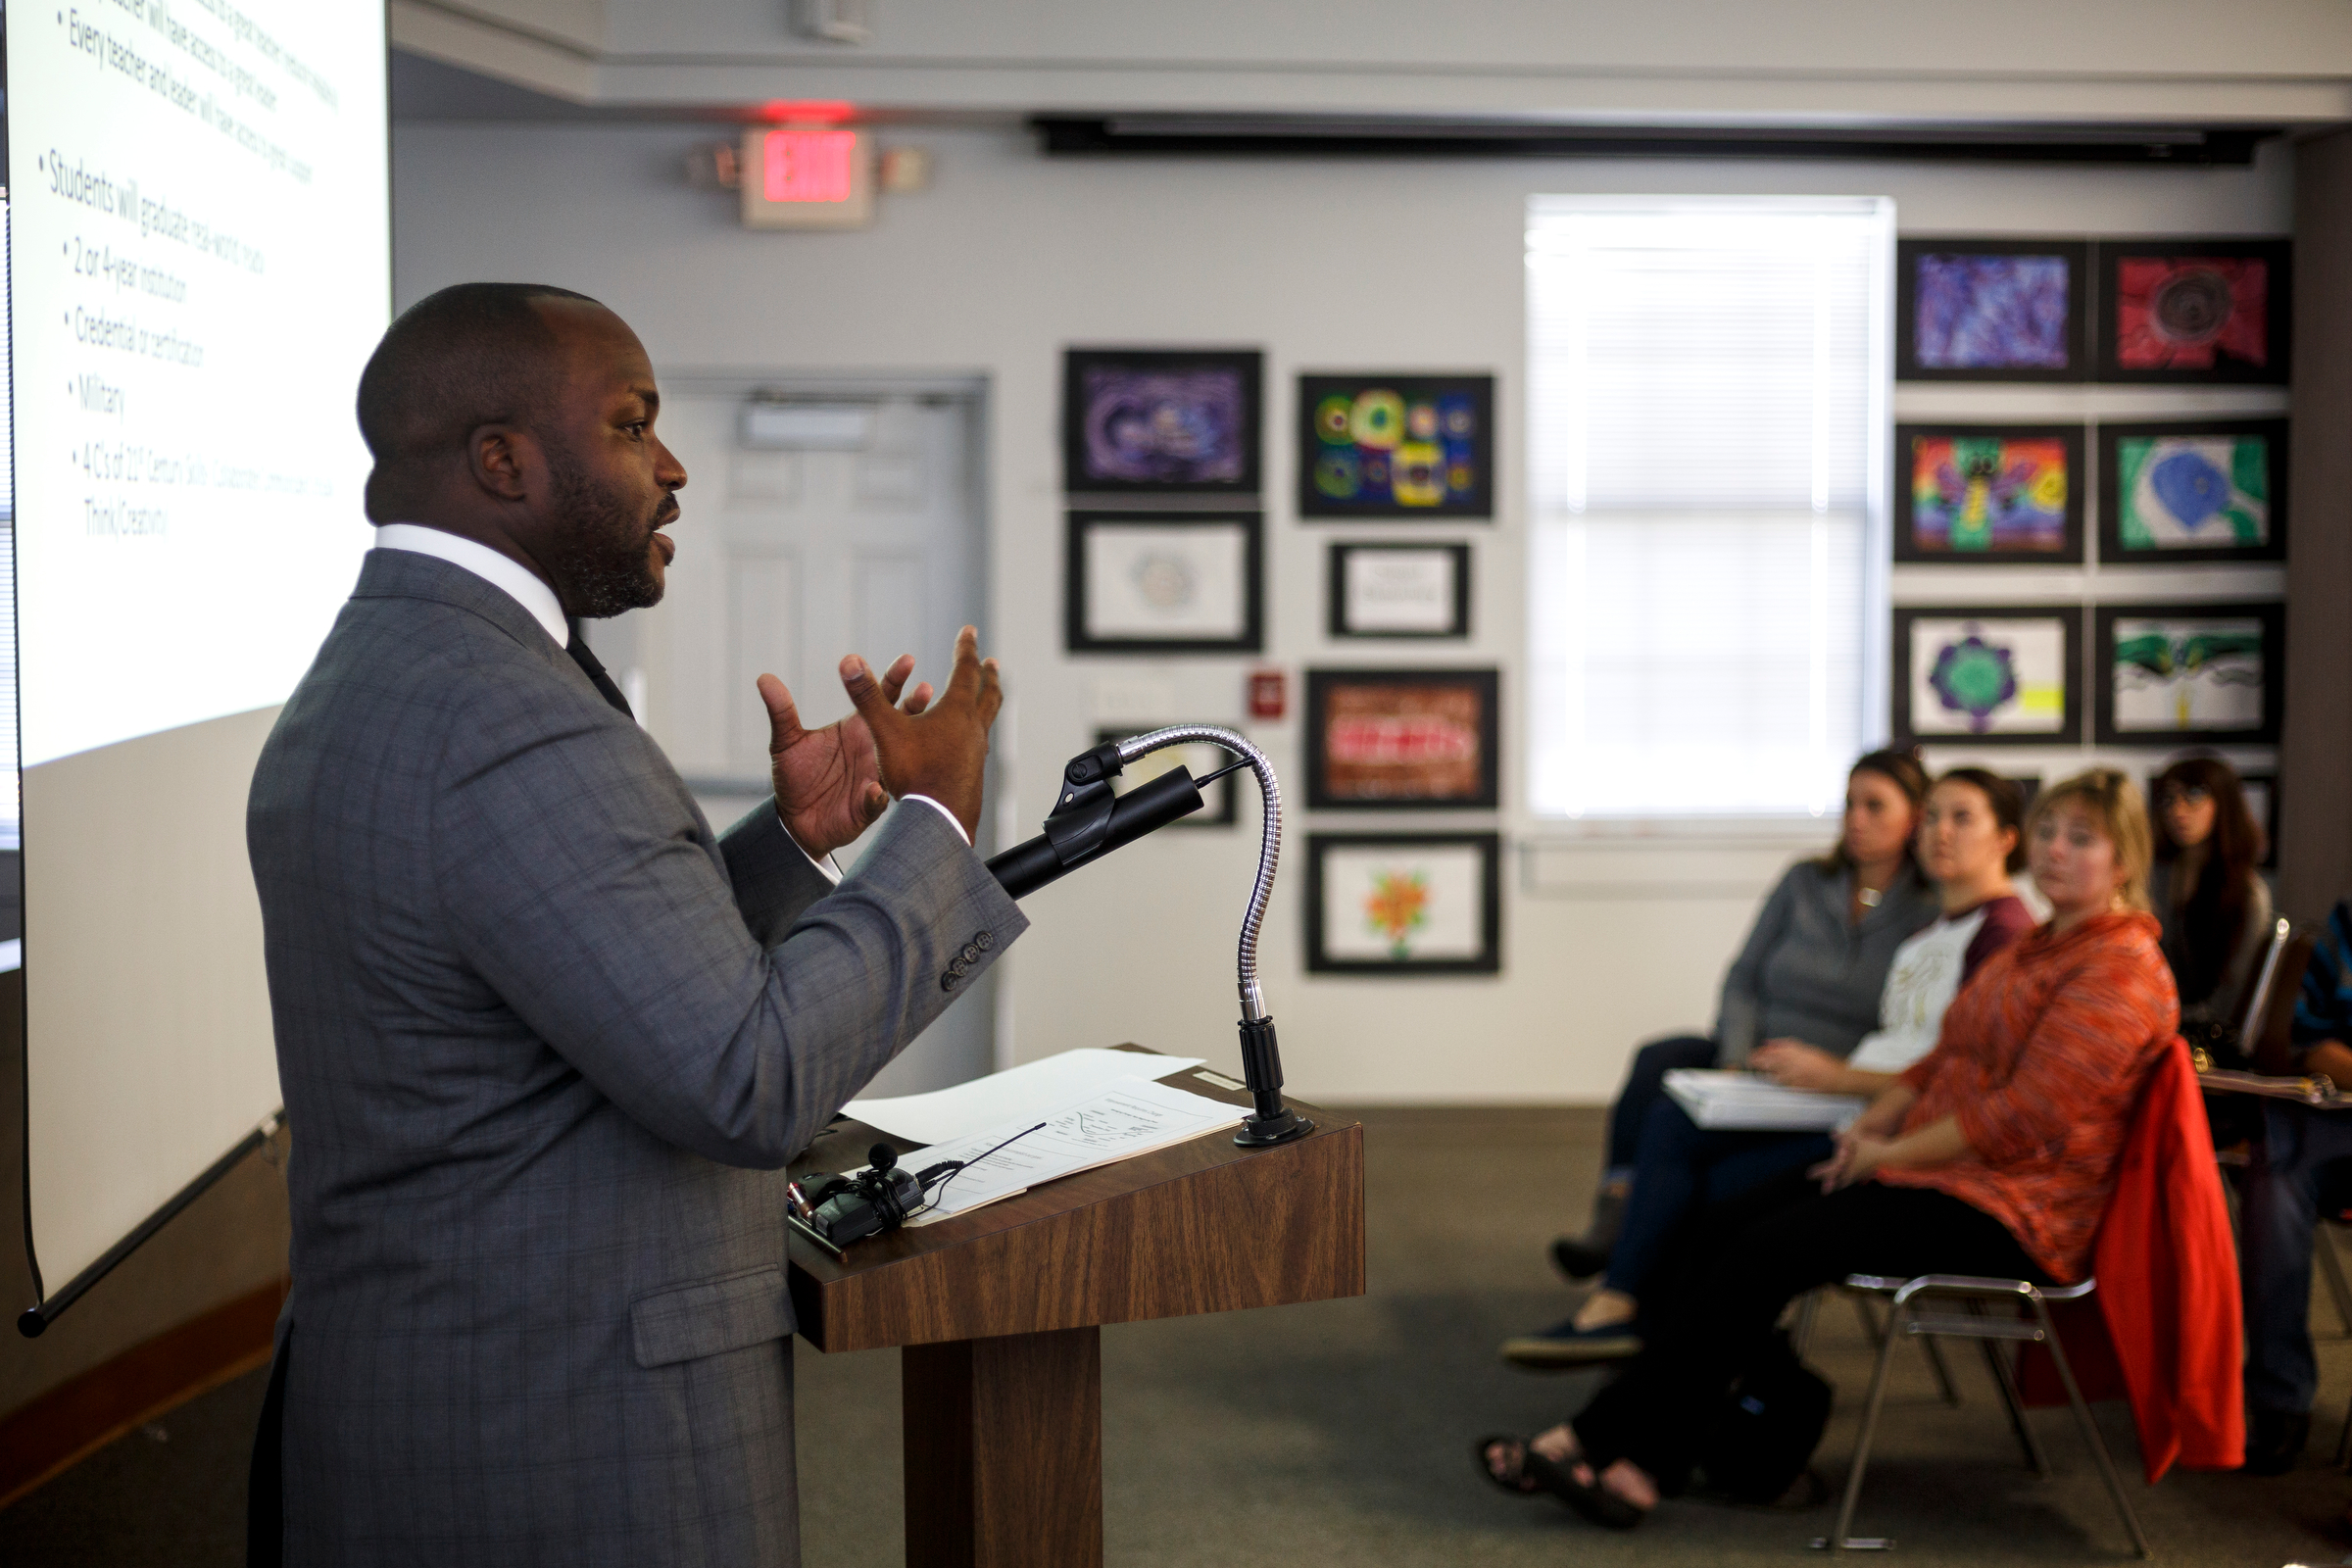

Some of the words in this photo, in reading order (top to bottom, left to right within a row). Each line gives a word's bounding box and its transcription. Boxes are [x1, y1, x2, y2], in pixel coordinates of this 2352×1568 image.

[70, 7, 105, 71] Every
[107, 30, 146, 84] teacher
[149, 59, 168, 98] and
[50, 148, 114, 215] Students
[116, 176, 139, 223] will
[140, 193, 189, 245] graduate
[74, 235, 82, 275] 2
[85, 247, 100, 277] or
[102, 244, 138, 295] 4-year
[139, 256, 188, 305] institution
[74, 304, 137, 355] Credential
[138, 327, 149, 355] or
[78, 371, 126, 426] Military
[83, 440, 92, 479] 4
[93, 440, 111, 480] C's
[112, 440, 124, 480] of
